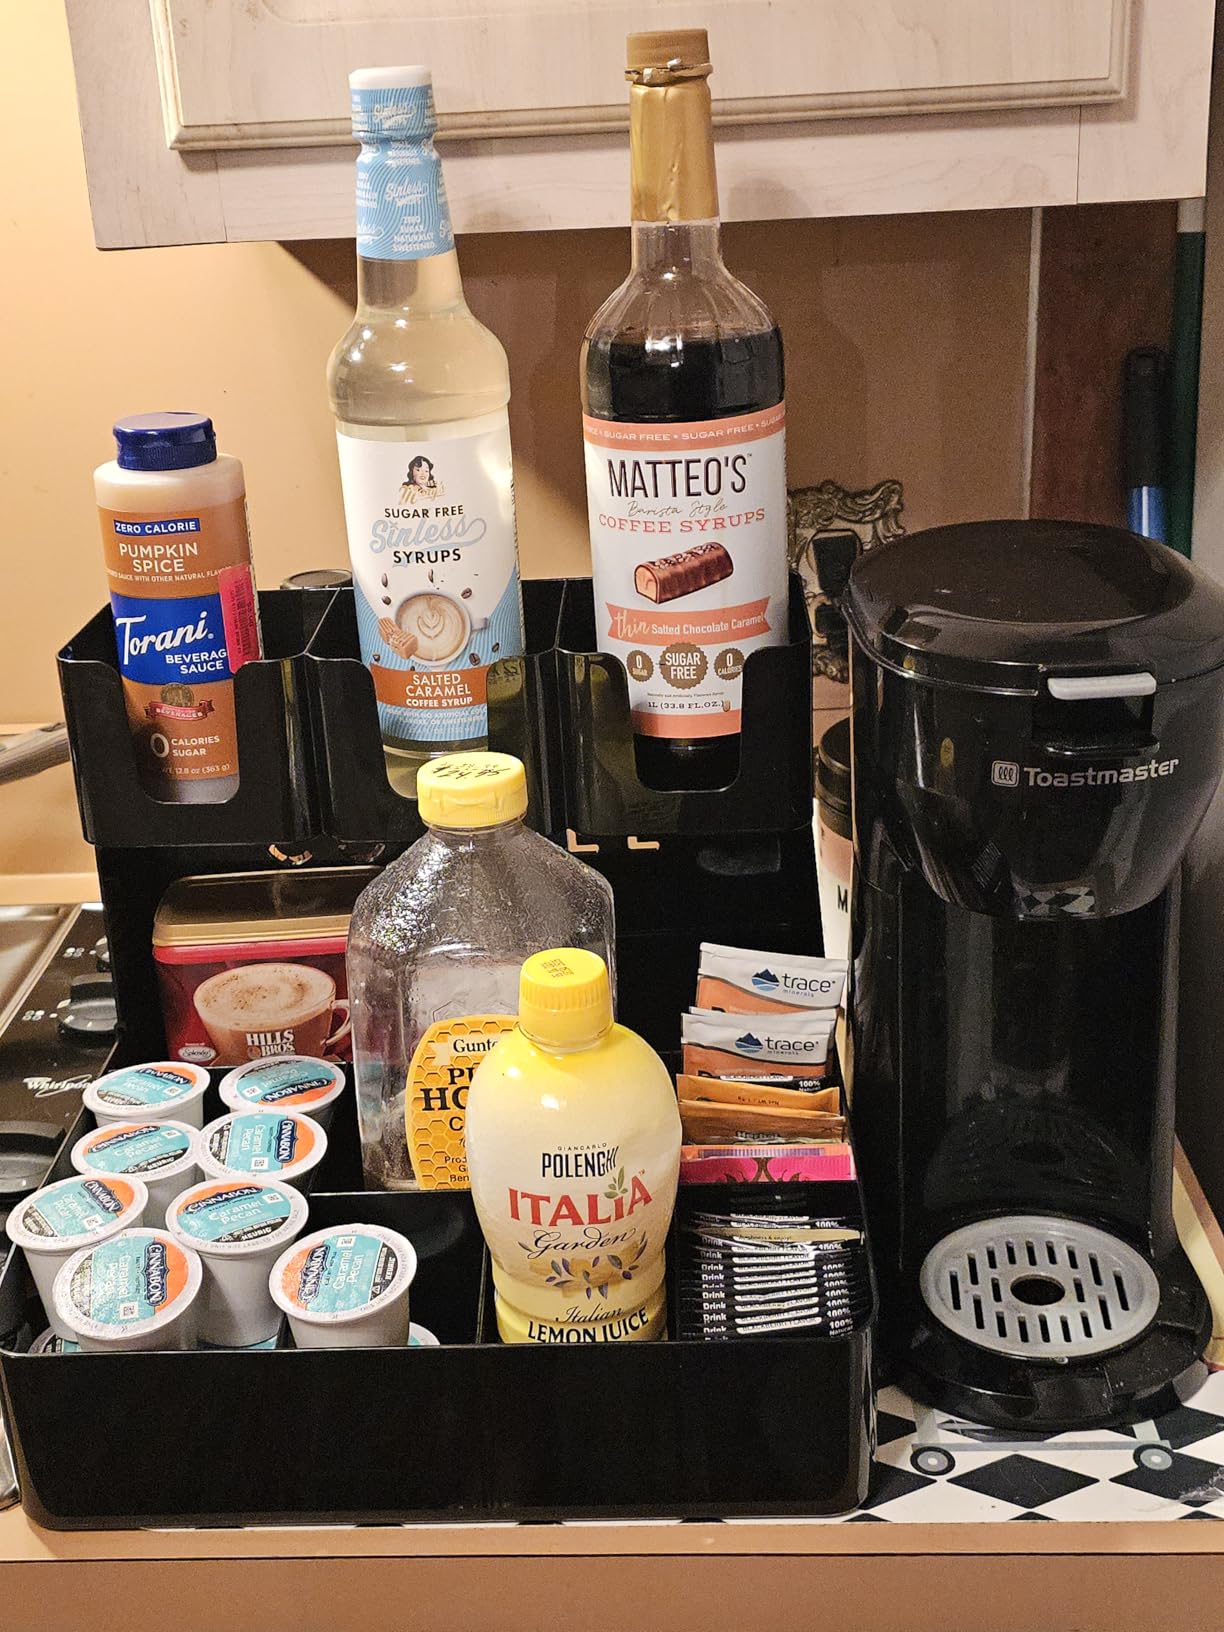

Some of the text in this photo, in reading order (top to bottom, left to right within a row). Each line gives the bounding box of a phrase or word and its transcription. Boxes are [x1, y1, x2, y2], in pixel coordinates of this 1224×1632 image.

[604, 430, 636, 440] SUGAR
[639, 433, 670, 441] FREE
[681, 424, 754, 440] SUGAR FREE
[607, 454, 747, 498] MATTEO'S
[384, 505, 464, 519] SUGAR FREE
[627, 498, 728, 518] Barista Style
[115, 521, 196, 534] ZERO CALORIE
[599, 508, 765, 534] COFFEE SYRUPS
[369, 513, 487, 554] Sinless
[119, 542, 198, 558] PUMPKIN
[393, 548, 461, 564] SYRUPS
[133, 559, 185, 573] SPICE
[175, 572, 205, 581] NATURAL
[614, 610, 764, 638] thin Salted Chocolate Caramel
[115, 611, 209, 666] Torani
[165, 648, 227, 664] BEVERAG
[635, 655, 643, 669] 0
[665, 652, 701, 666] SUGAR
[726, 653, 734, 667] 0
[180, 660, 224, 674] SAUCE
[632, 667, 648, 676] SUGAR
[670, 666, 697, 679] FREE
[412, 673, 461, 686] SALTED
[405, 683, 471, 697] CARAMEL
[406, 697, 473, 707] COFFEE SYRUP
[151, 733, 220, 758] 0 CALORIES
[172, 748, 207, 757] SUGAR
[1024, 758, 1180, 787] Toastmaster
[782, 973, 831, 993] trace
[783, 989, 814, 998] minerals
[245, 1029, 296, 1047] HILLS
[765, 1036, 815, 1051] trace
[23, 1076, 91, 1093] Whirlpoo
[264, 1079, 328, 1101] CINNABON
[557, 1142, 607, 1150] GIANCARLO
[541, 1146, 619, 1178] POLENGHI
[187, 1186, 259, 1213] CINNABON
[508, 1174, 653, 1227] ITALIA
[208, 1200, 264, 1221] Caramel
[221, 1208, 262, 1225] Pecan
[241, 1227, 272, 1240] KEURIG
[527, 1227, 636, 1260] Garden
[149, 1244, 164, 1304] CINNABON
[300, 1247, 325, 1300] CINNABON
[332, 1249, 352, 1290] Caramel
[346, 1254, 364, 1283] Pecan
[701, 1263, 724, 1271] Drink
[702, 1273, 724, 1281] Drink
[702, 1291, 725, 1300] Drink
[555, 1303, 624, 1324] Italian
[703, 1302, 726, 1310] Drink
[528, 1307, 649, 1343] LEMON JUICE
[703, 1313, 727, 1321] Drink
[829, 1319, 853, 1329] 100%
